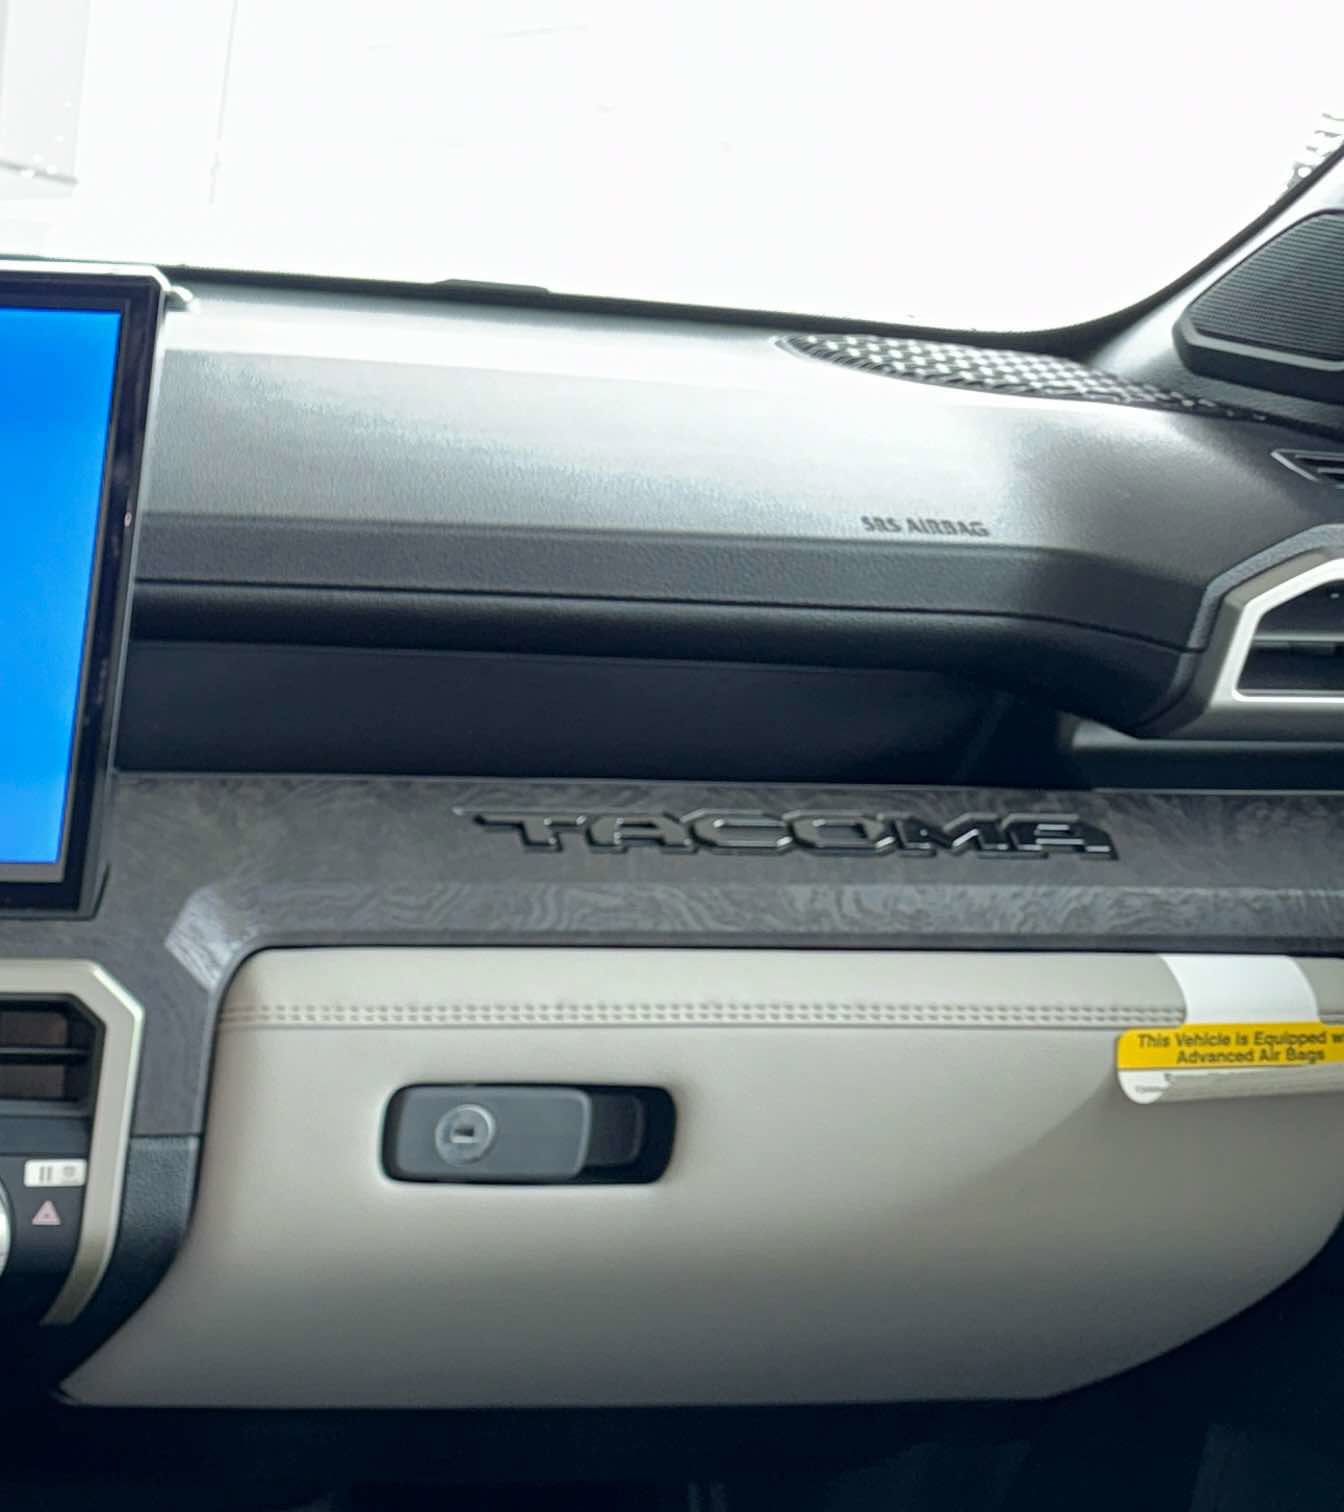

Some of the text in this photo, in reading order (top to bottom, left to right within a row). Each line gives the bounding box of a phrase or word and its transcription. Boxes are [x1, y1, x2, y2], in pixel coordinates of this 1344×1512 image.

[861, 515, 990, 537] SRS AIRBAG
[462, 807, 1118, 861] TACOMA
[1138, 1033, 1171, 1048] This
[1176, 1032, 1231, 1047] Vehicle
[1253, 1030, 1327, 1049] Equipped
[1176, 1046, 1326, 1065] Advanced Air Bags
